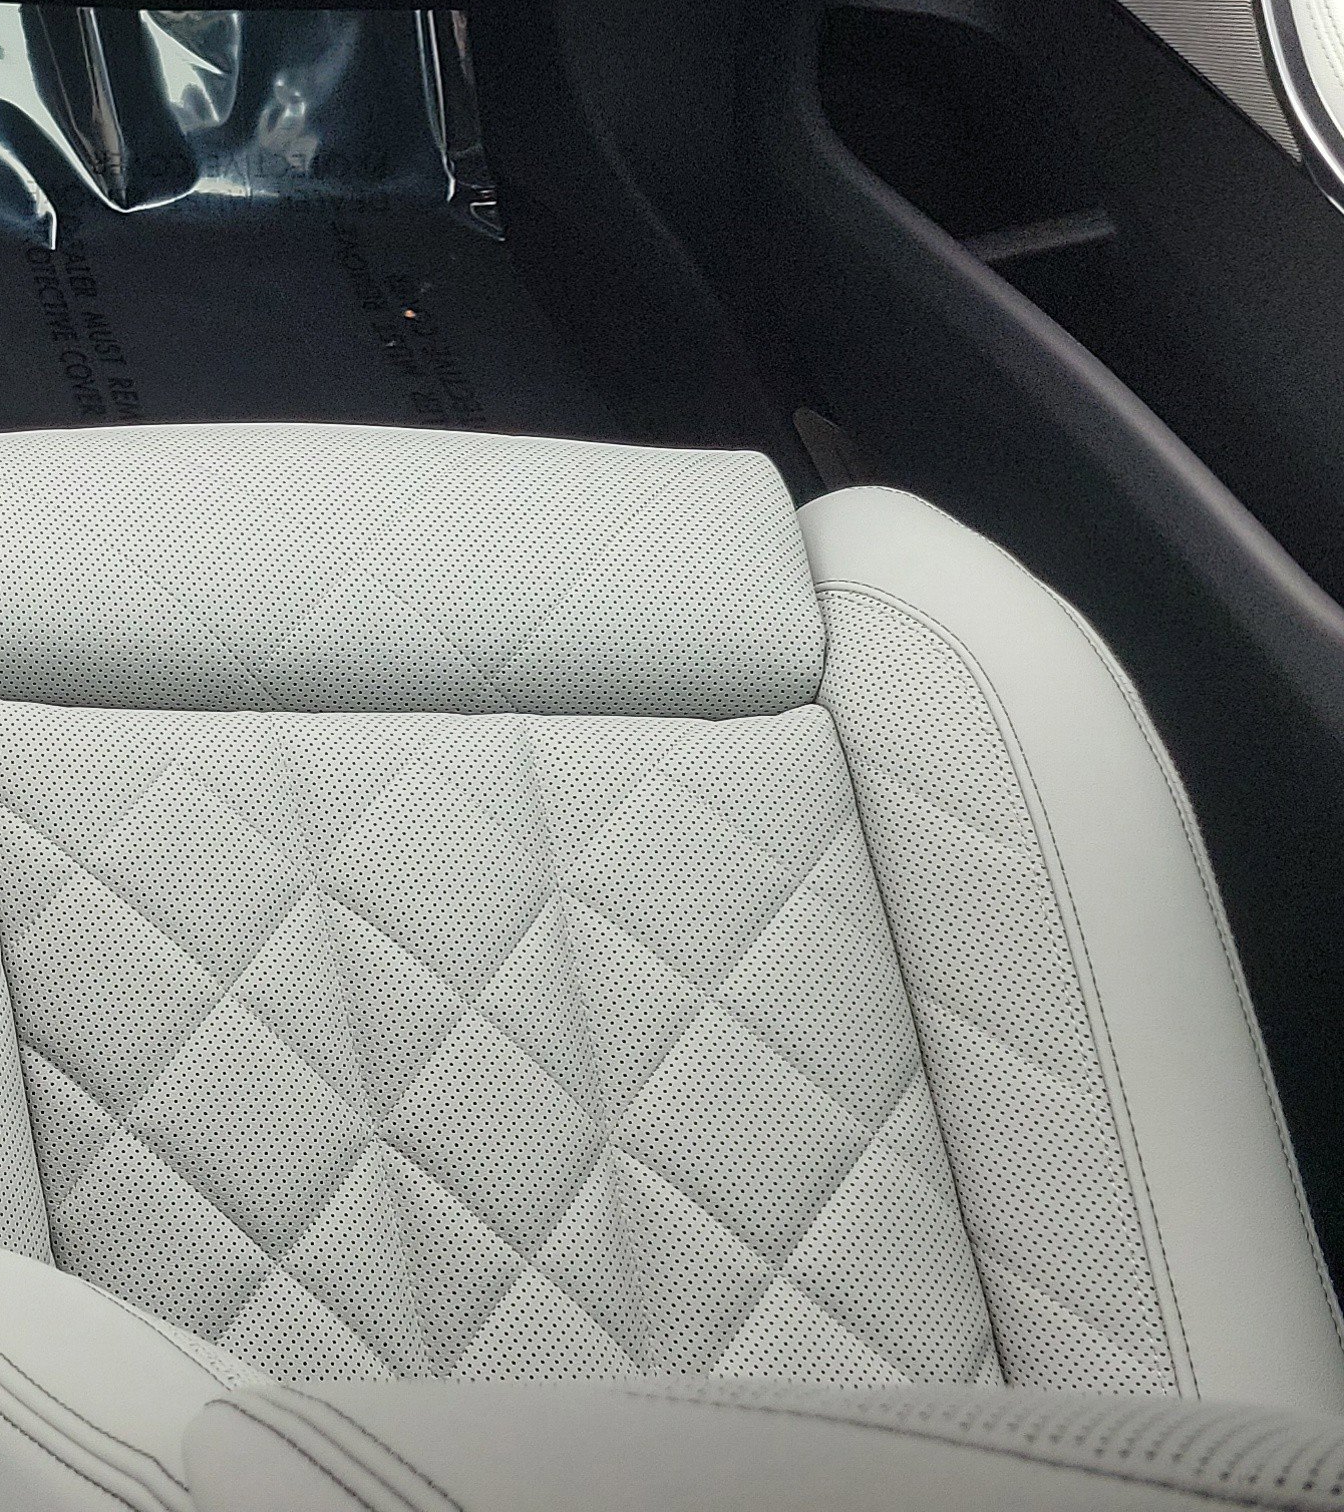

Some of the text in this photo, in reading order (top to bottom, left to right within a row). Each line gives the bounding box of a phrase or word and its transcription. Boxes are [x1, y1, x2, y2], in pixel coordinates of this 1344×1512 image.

[26, 245, 106, 417] OTECTIVE COVER
[83, 311, 128, 365] MUST
[109, 377, 140, 422] REM
